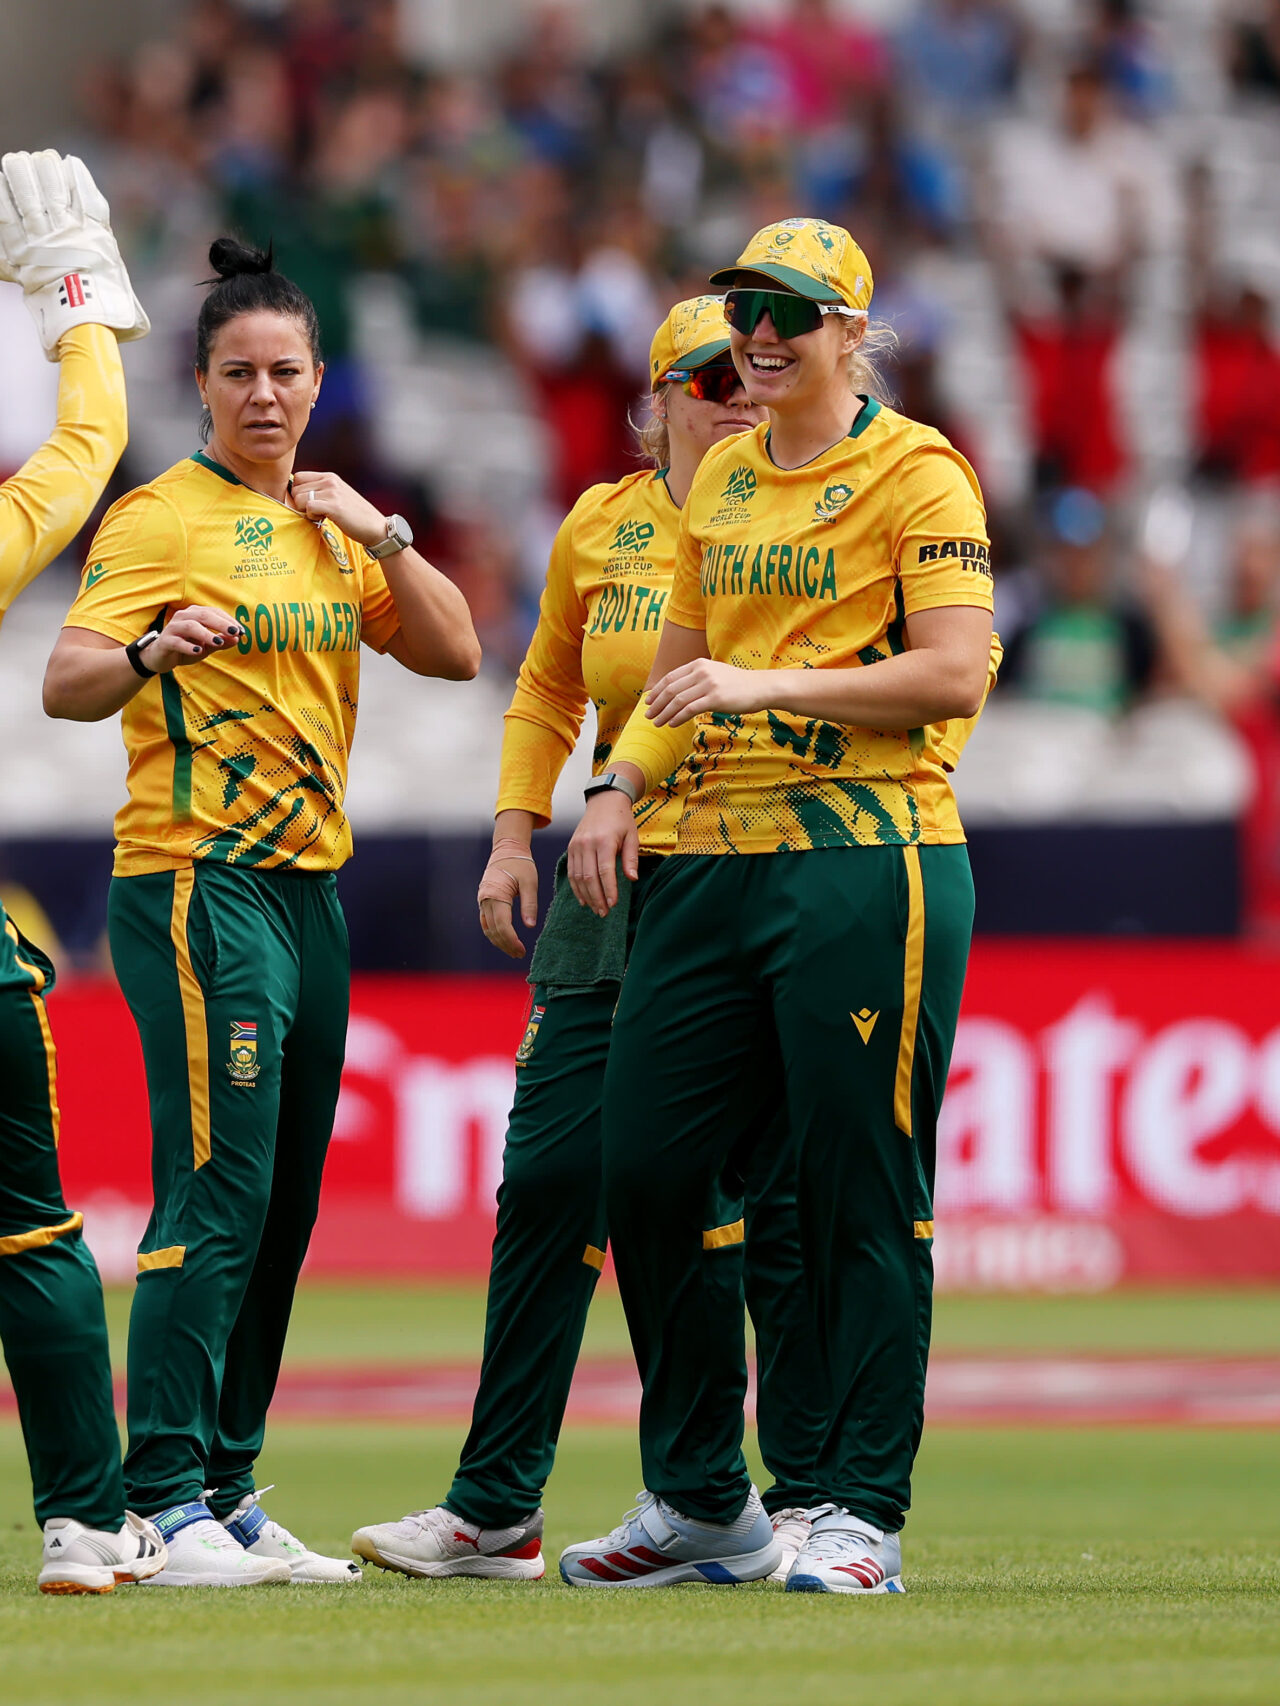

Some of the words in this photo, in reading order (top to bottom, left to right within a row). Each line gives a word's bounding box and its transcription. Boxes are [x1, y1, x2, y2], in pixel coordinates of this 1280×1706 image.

[709, 513, 733, 524] WORLD
[250, 549, 266, 557] ICC
[918, 541, 991, 564] RADA
[234, 563, 269, 573] WORLD
[270, 561, 288, 570] CUP
[603, 562, 631, 574] WORLD
[633, 562, 653, 571] CUP
[700, 544, 749, 598] OUTH
[749, 544, 838, 601] AFRICA
[960, 558, 994, 580] TYRE
[590, 584, 668, 634] SOUTH
[236, 603, 315, 655] SOUTH
[316, 602, 363, 652] AFRI
[159, 1509, 186, 1530] PUMA
